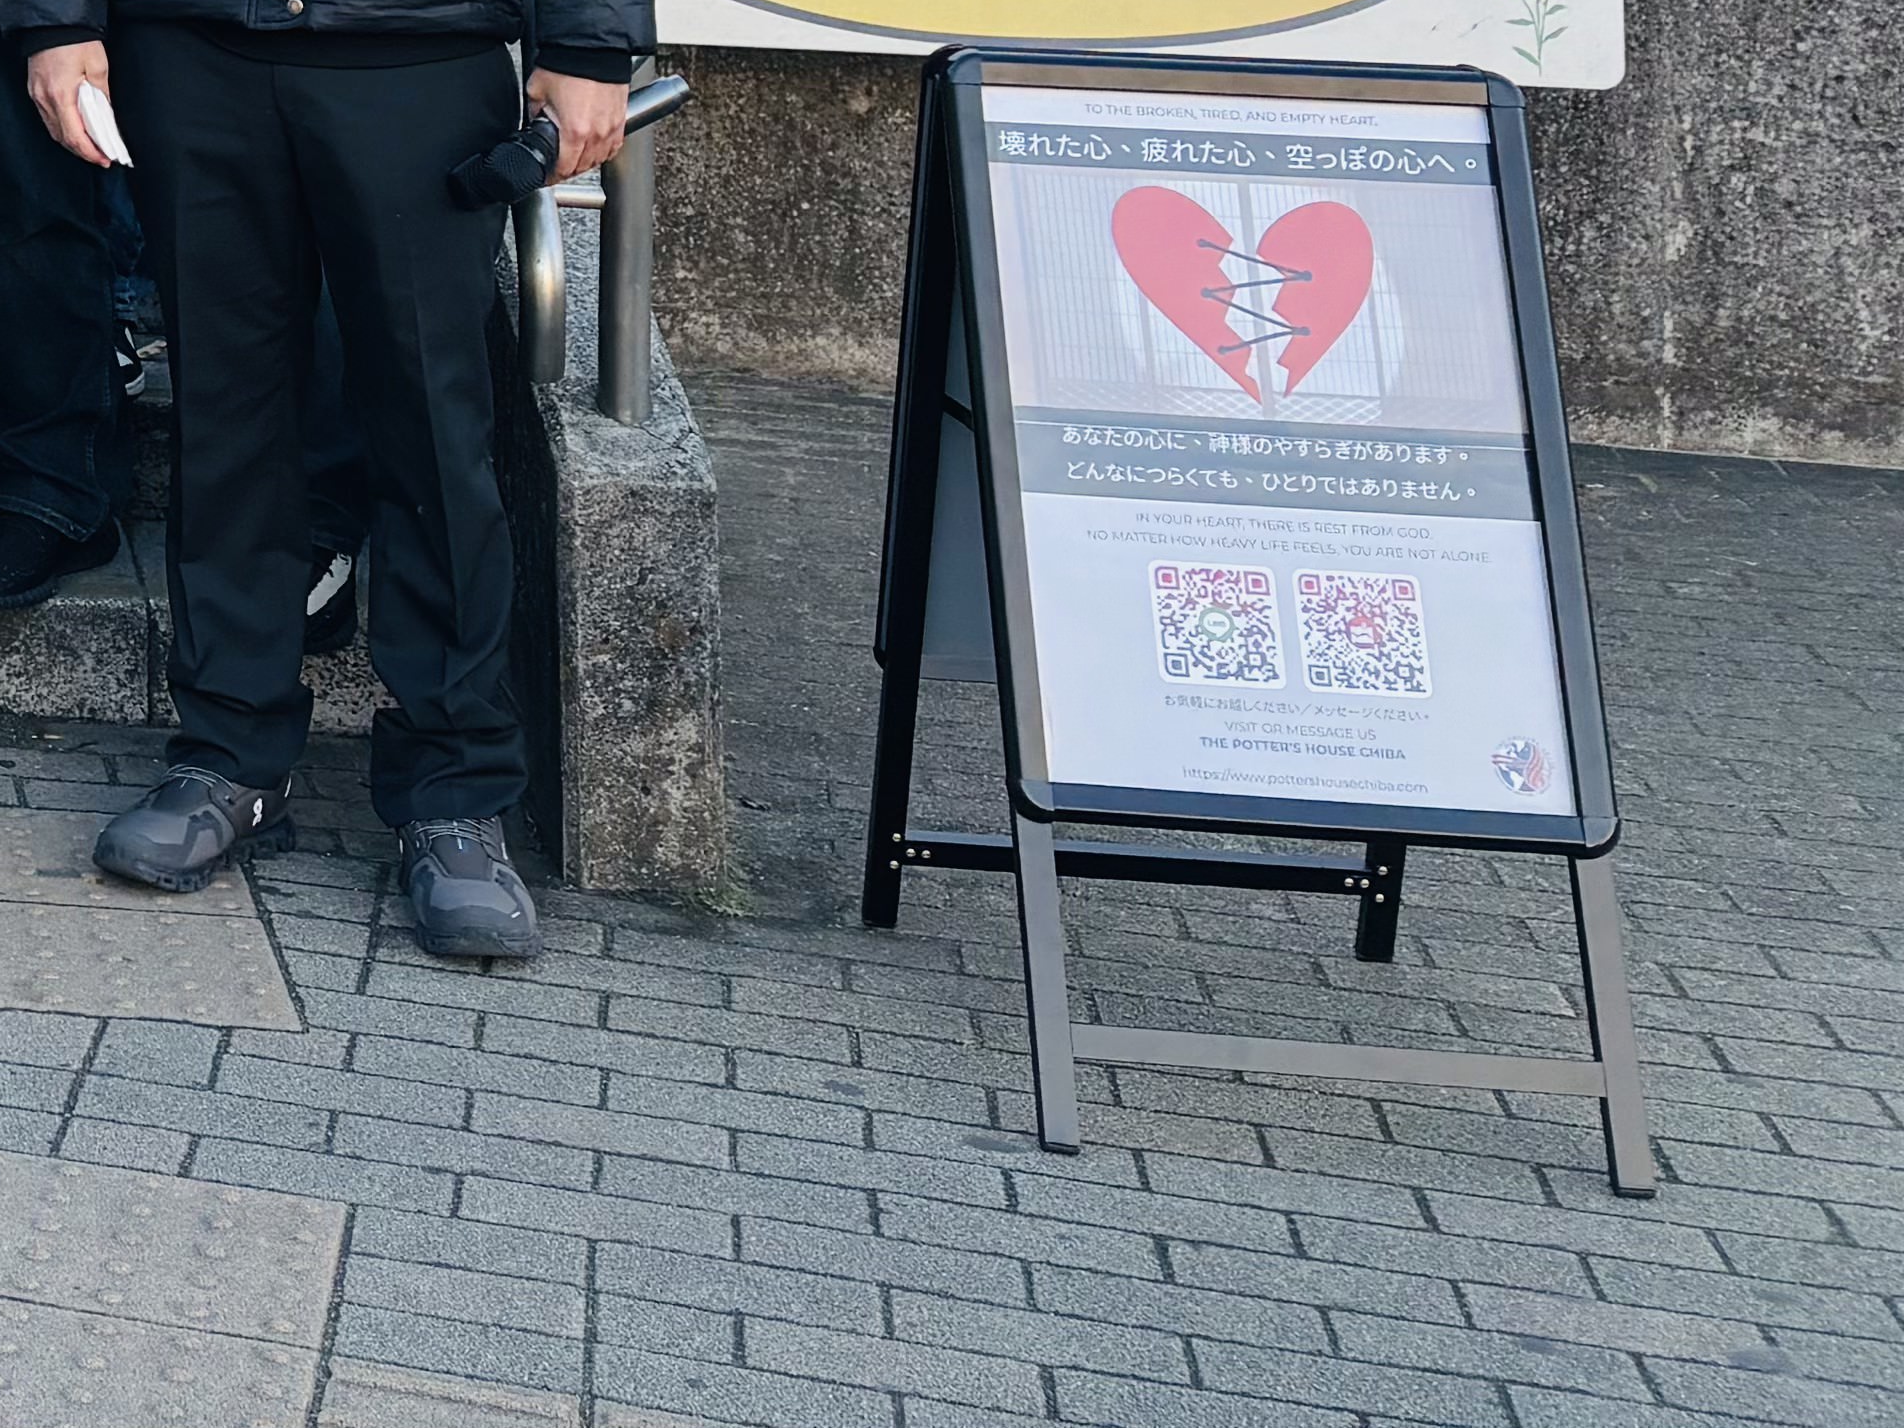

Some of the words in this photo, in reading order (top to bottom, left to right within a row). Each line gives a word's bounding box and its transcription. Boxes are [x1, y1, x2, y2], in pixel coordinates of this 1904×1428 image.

[1085, 103, 1103, 115] TO
[1105, 104, 1133, 117] THE
[1245, 110, 1276, 123] AND
[1281, 112, 1326, 126] EMPTY
[998, 128, 1478, 176] 壊れた心、疲れた心、空っぽの心へ。
[1136, 513, 1150, 524] IN
[1153, 514, 1193, 527] YOUR
[1249, 518, 1295, 533] THERE
[1298, 521, 1310, 533] IS
[1314, 521, 1349, 535] REST
[1352, 524, 1394, 538] FROM
[1087, 529, 1108, 541] NO
[1112, 531, 1168, 545] MATTER
[1171, 534, 1206, 547] HOW
[1210, 536, 1257, 551] HEAVY
[1261, 539, 1290, 552] LIFE
[1343, 544, 1371, 557] YOU
[1374, 546, 1403, 559] ARE
[1408, 548, 1438, 561] NOT
[1224, 720, 1257, 733] VISIT
[1261, 722, 1284, 735] OR
[1286, 724, 1356, 740] MESSAGE
[1357, 728, 1377, 741] US
[1199, 736, 1228, 750] THE
[1233, 738, 1302, 754] POTTER'S
[1305, 743, 1356, 758] HOUSE
[1360, 746, 1406, 760] CHIBA
